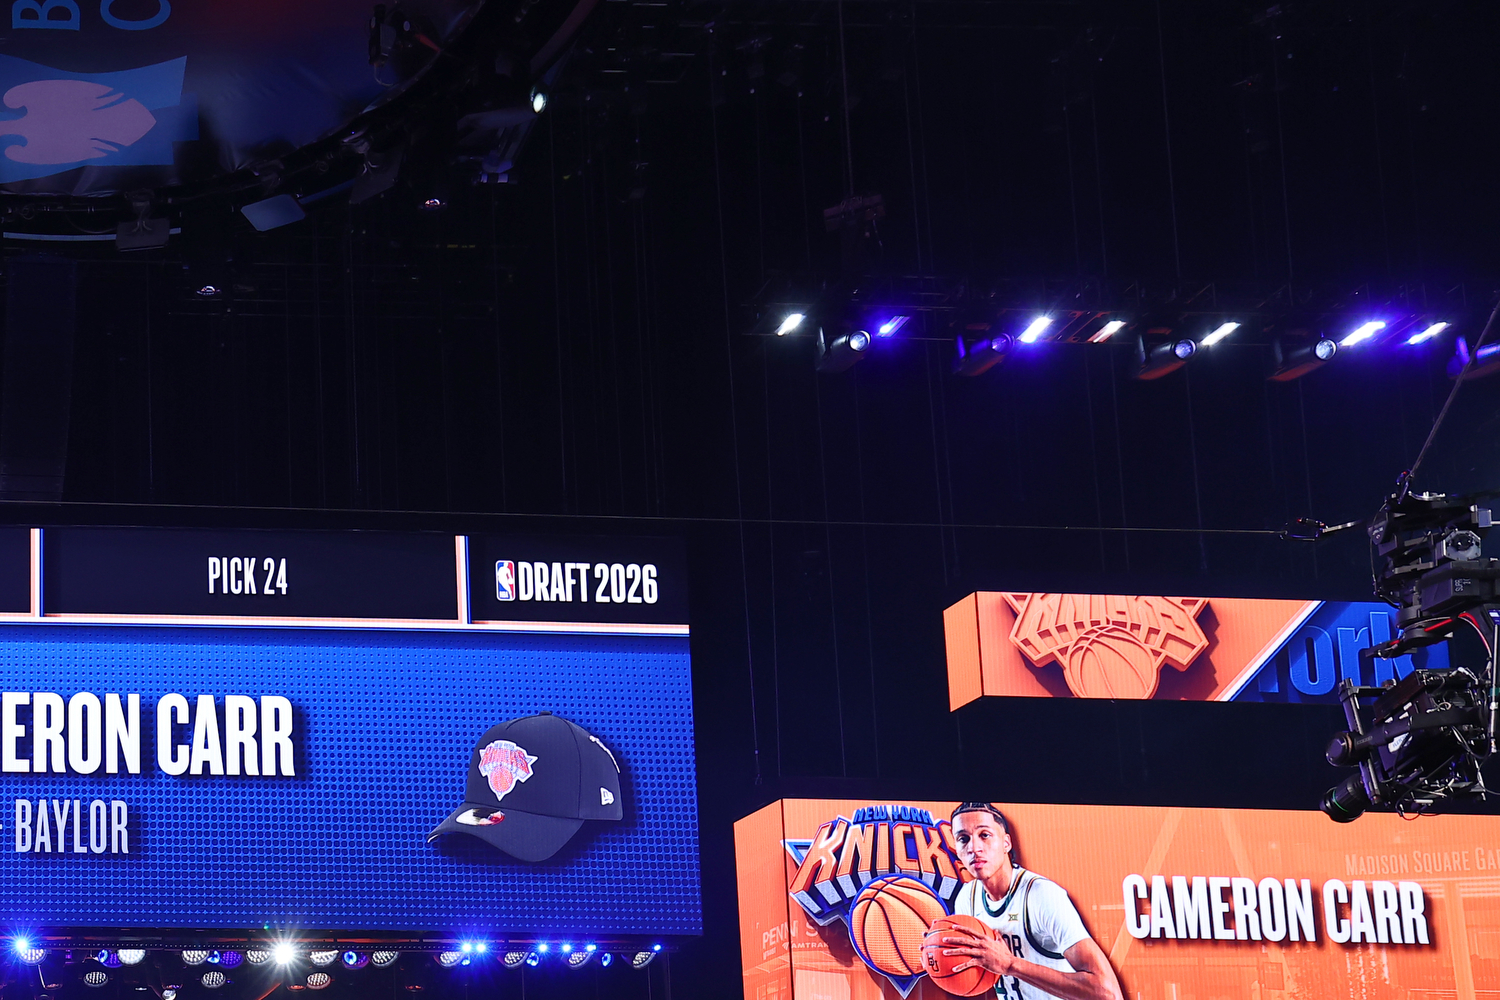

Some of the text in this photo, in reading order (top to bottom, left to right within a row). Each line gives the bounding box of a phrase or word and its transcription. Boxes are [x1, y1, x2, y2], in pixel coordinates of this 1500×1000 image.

[208, 556, 288, 595] PICK 24
[518, 561, 658, 604] DRAFT 2026
[156, 693, 296, 778] CARR
[15, 798, 130, 855] BAYLOR
[853, 805, 934, 825] NEW YORK
[1345, 853, 1409, 876] MADISON
[1413, 850, 1471, 875] SQUARE
[1123, 874, 1430, 945] CAMERON CARR
[762, 920, 798, 950] PENN
